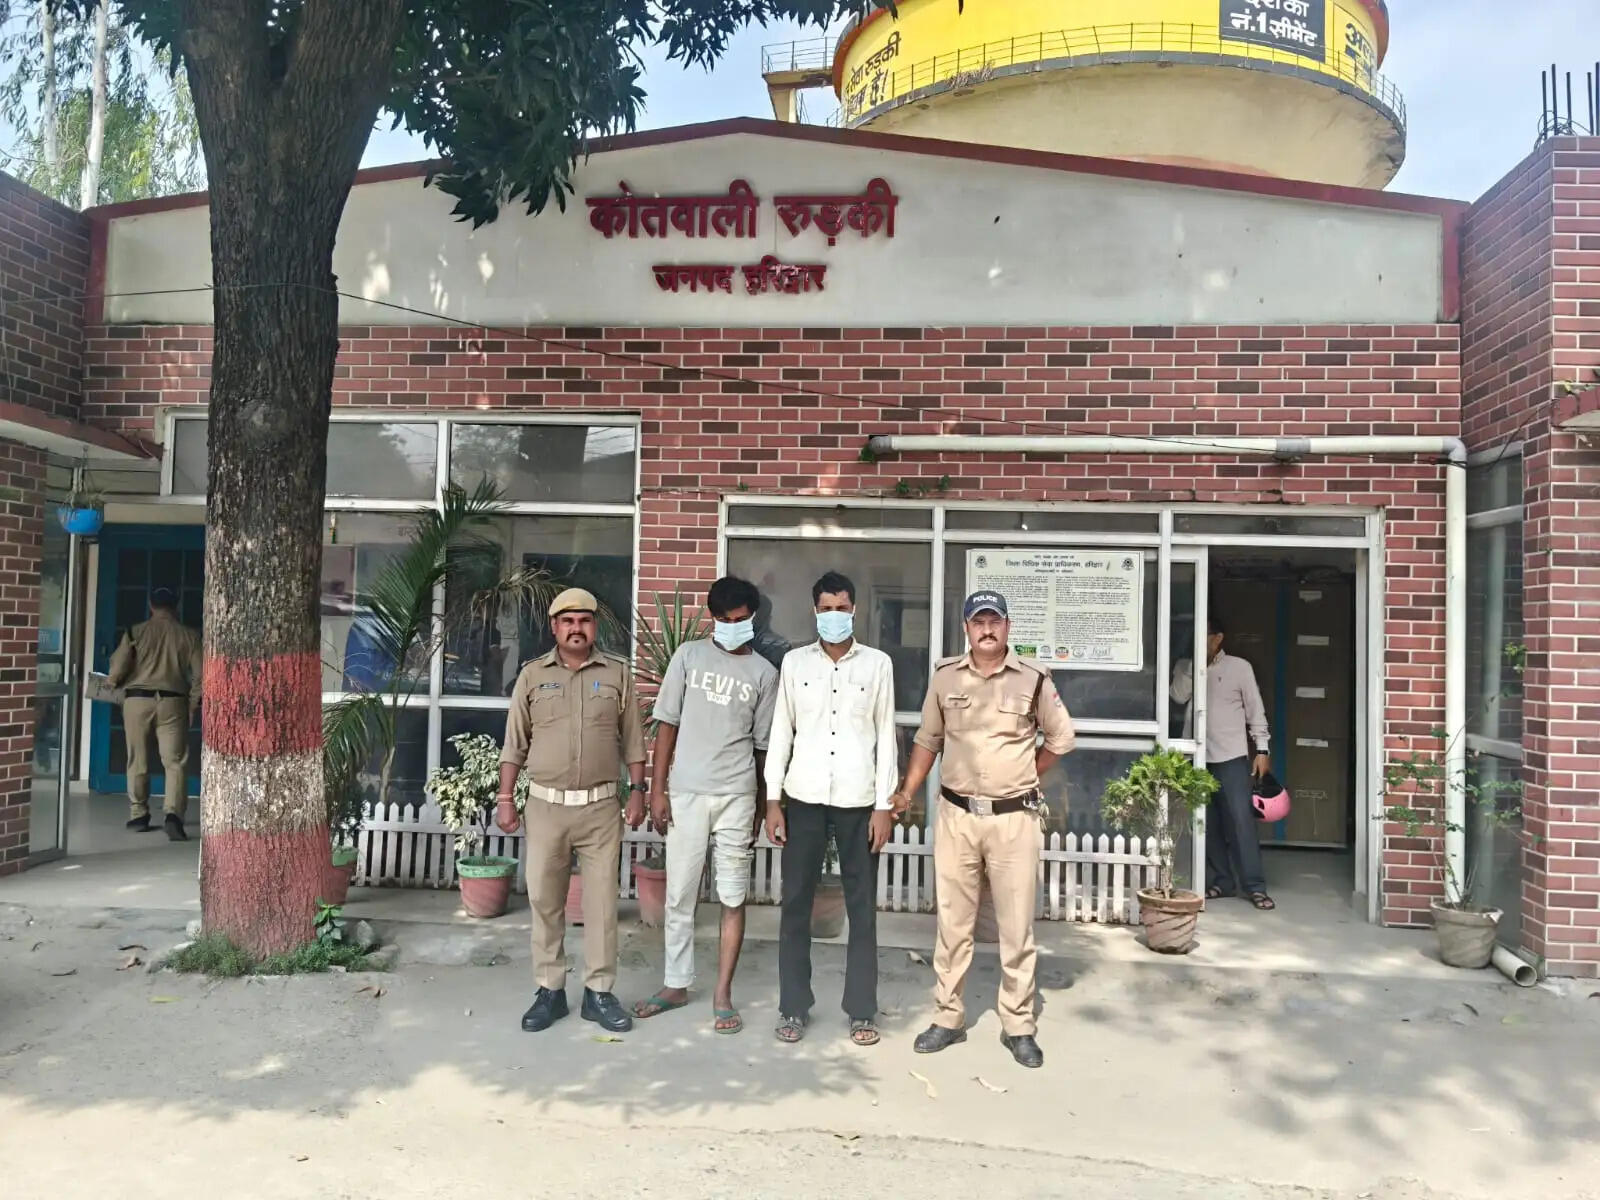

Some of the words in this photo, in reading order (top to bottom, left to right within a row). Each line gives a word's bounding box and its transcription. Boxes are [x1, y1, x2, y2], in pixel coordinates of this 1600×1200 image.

[1269, 16, 1318, 47] सीमेंट
[585, 179, 760, 239] कोतवाली
[773, 177, 899, 247] रुड़की
[652, 264, 735, 294] जनपद
[741, 255, 827, 296] हरिद्वार
[973, 594, 998, 604] POLICE
[690, 669, 753, 702] LEVI'S
